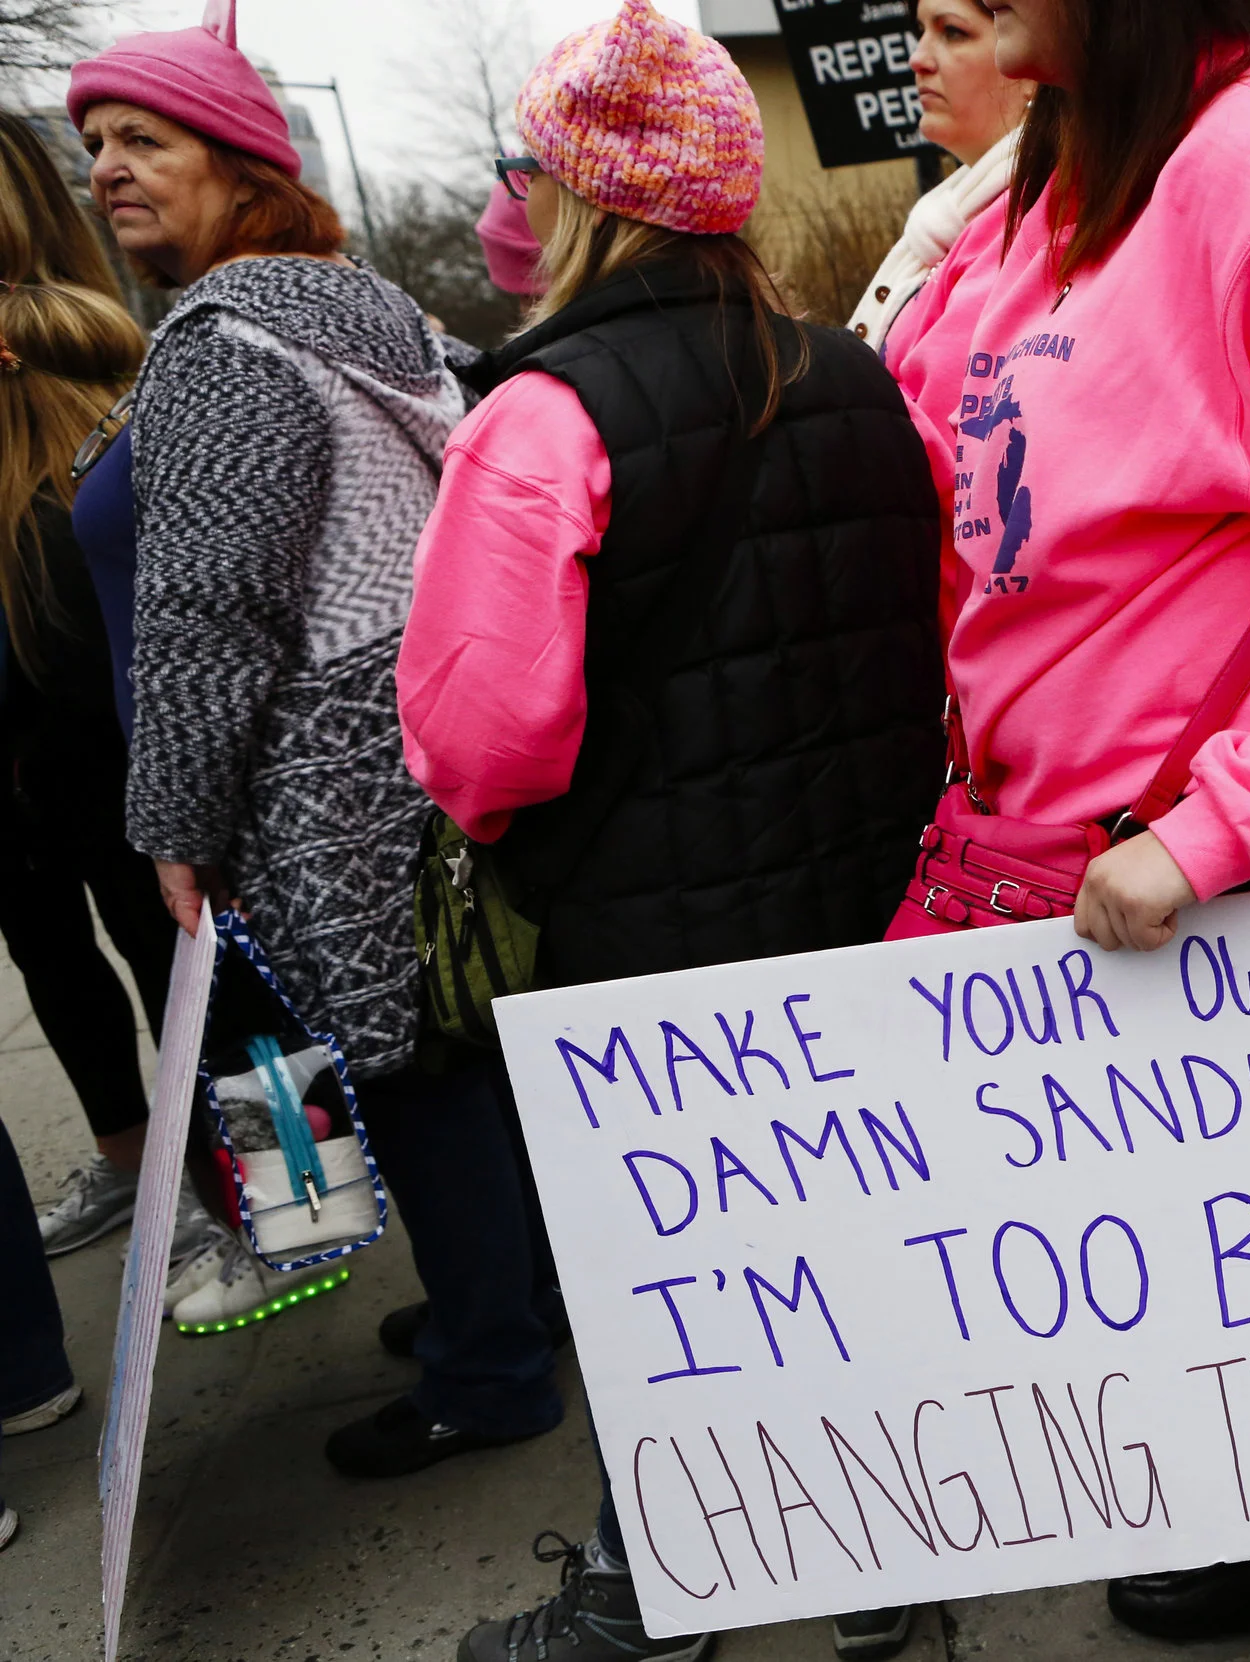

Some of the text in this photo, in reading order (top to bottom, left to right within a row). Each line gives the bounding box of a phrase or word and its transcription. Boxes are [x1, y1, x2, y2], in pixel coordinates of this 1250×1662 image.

[555, 994, 855, 1128] MAKE
[909, 949, 1120, 1061] YOUR
[622, 1101, 930, 1236] DAMN
[632, 1256, 850, 1383] I'M
[904, 1214, 1148, 1340] TOO
[634, 1373, 1171, 1599] CHANGING
